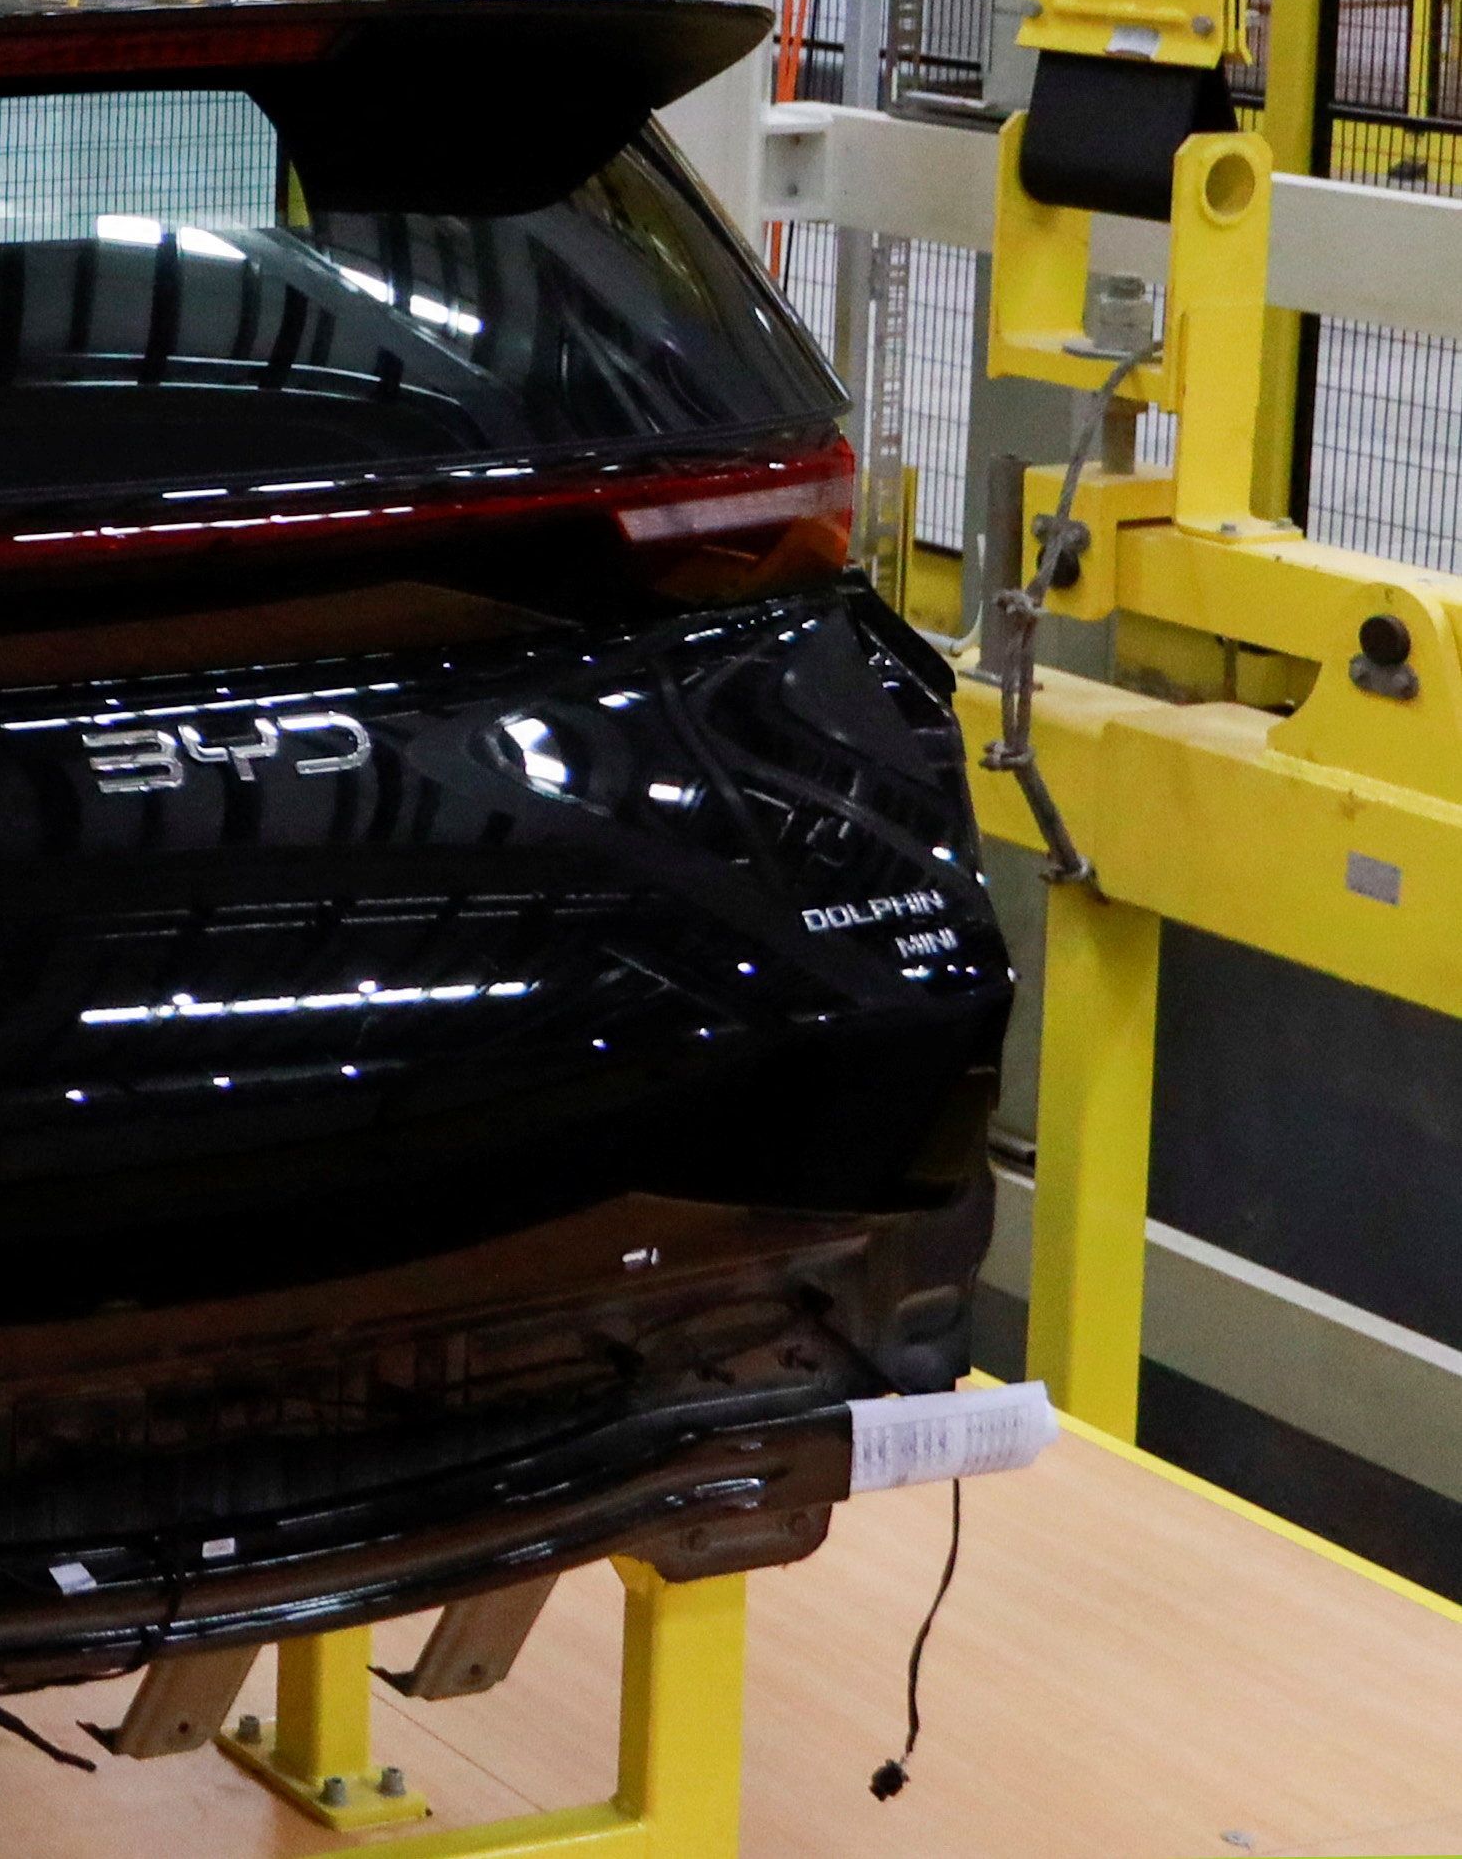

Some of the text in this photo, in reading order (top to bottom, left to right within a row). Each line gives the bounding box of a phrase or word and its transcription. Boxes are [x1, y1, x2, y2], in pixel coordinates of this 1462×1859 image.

[82, 710, 372, 794] BYD
[801, 889, 946, 932] DOLPHIN
[895, 927, 959, 959] MINI
